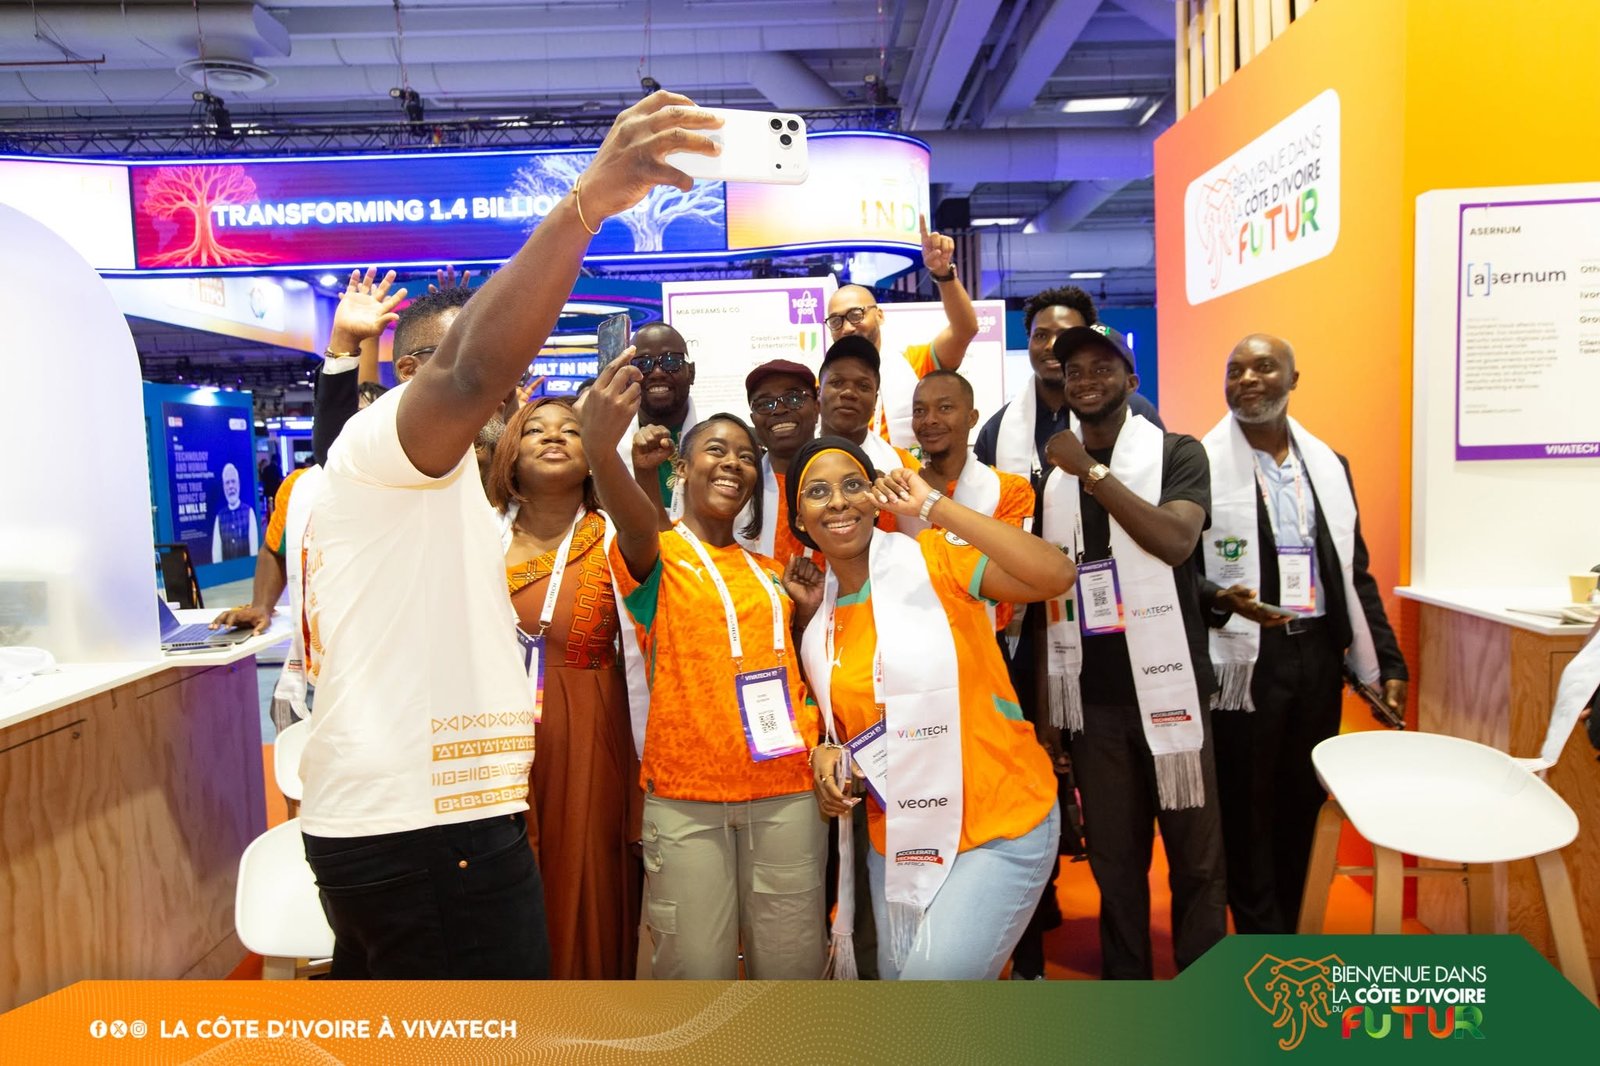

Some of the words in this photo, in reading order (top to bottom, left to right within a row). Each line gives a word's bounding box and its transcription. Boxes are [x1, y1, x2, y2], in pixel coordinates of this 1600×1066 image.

[1234, 147, 1287, 198] BIENVENUE
[1288, 125, 1322, 166] DANS
[1244, 188, 1269, 217] CÔTE
[213, 201, 423, 226] TRANSFORMING
[430, 199, 467, 220] 1.4
[860, 200, 918, 232] IND
[1238, 188, 1320, 265] FUTUR
[1469, 226, 1522, 236] ASERNUM
[1580, 265, 1600, 273] Oth
[1580, 291, 1600, 299] Ivor
[691, 307, 720, 315] DREAMS
[1579, 315, 1600, 324] Gro
[531, 363, 559, 376] UILT
[560, 362, 575, 376] IN
[1545, 443, 1599, 455] VIVATECH
[1132, 605, 1173, 617] VIVATECH
[1142, 662, 1183, 675] veone
[898, 725, 948, 739] VIVATECH
[898, 797, 948, 809] veone
